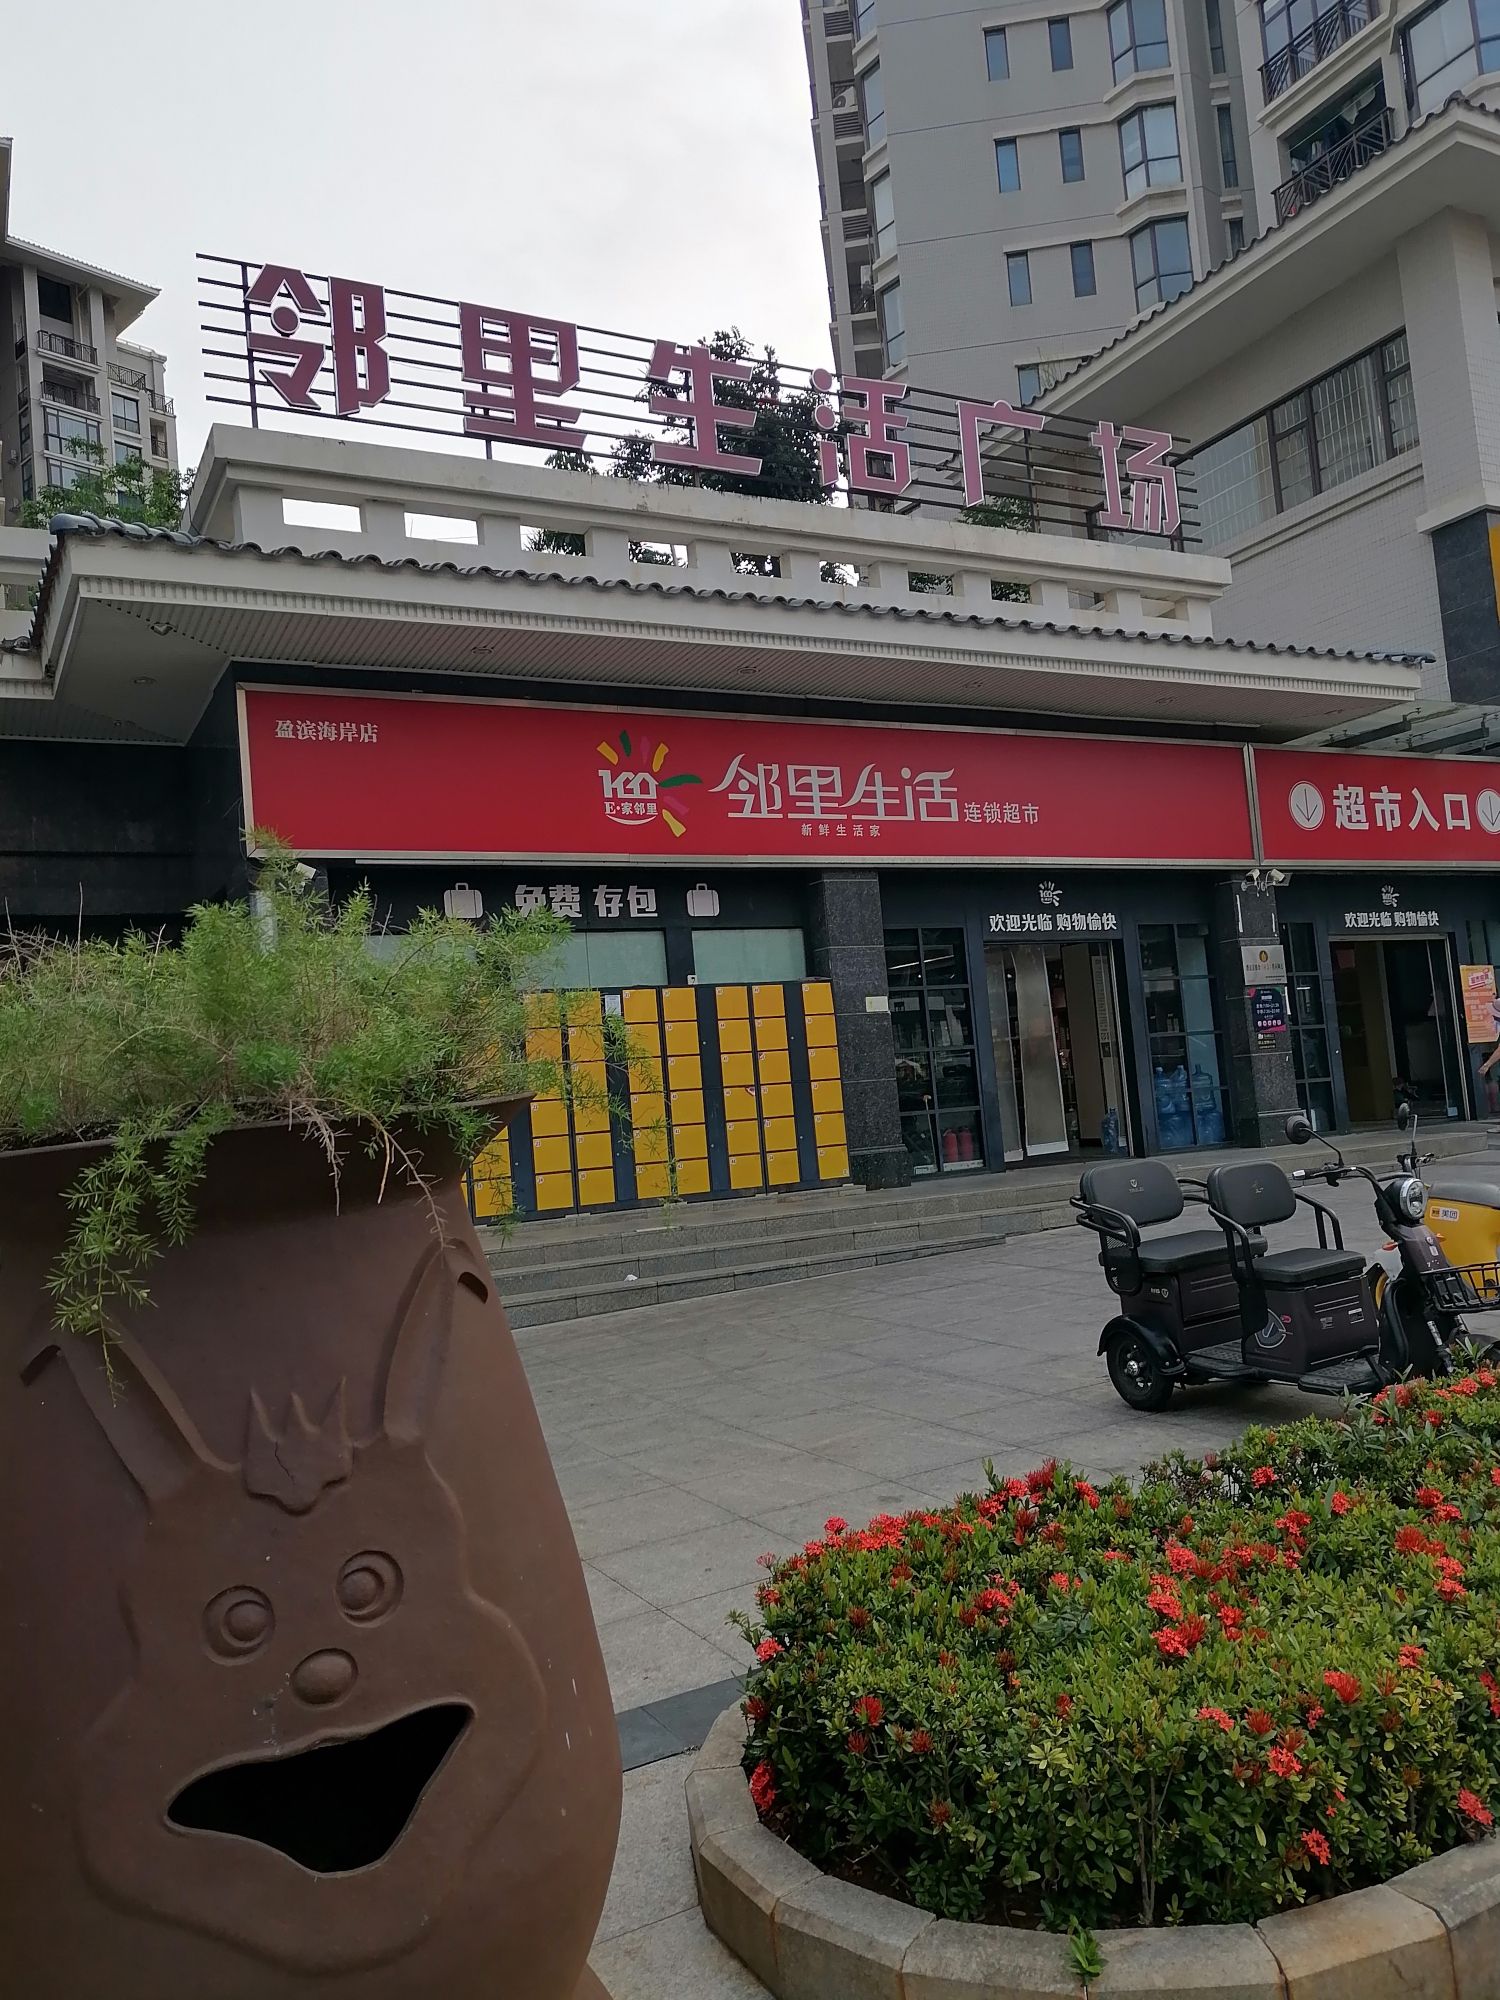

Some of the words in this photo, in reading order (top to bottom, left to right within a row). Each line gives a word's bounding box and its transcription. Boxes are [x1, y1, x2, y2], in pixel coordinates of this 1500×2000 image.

[244, 263, 1181, 535] 邻里生活广场
[274, 719, 378, 743] 盈滨海岸店
[708, 753, 959, 823] 邻里生活
[963, 801, 1040, 825] 连锁超市
[1332, 783, 1471, 832] 超市入口
[801, 822, 881, 837] 新鲜生活家
[514, 884, 583, 918] 免费
[592, 884, 659, 918] 存包
[989, 913, 1053, 932] 欢迎光临
[1056, 912, 1117, 931] 购物愉快
[1344, 912, 1392, 928] 欢迎光临
[1394, 911, 1440, 928] 购物愉快
